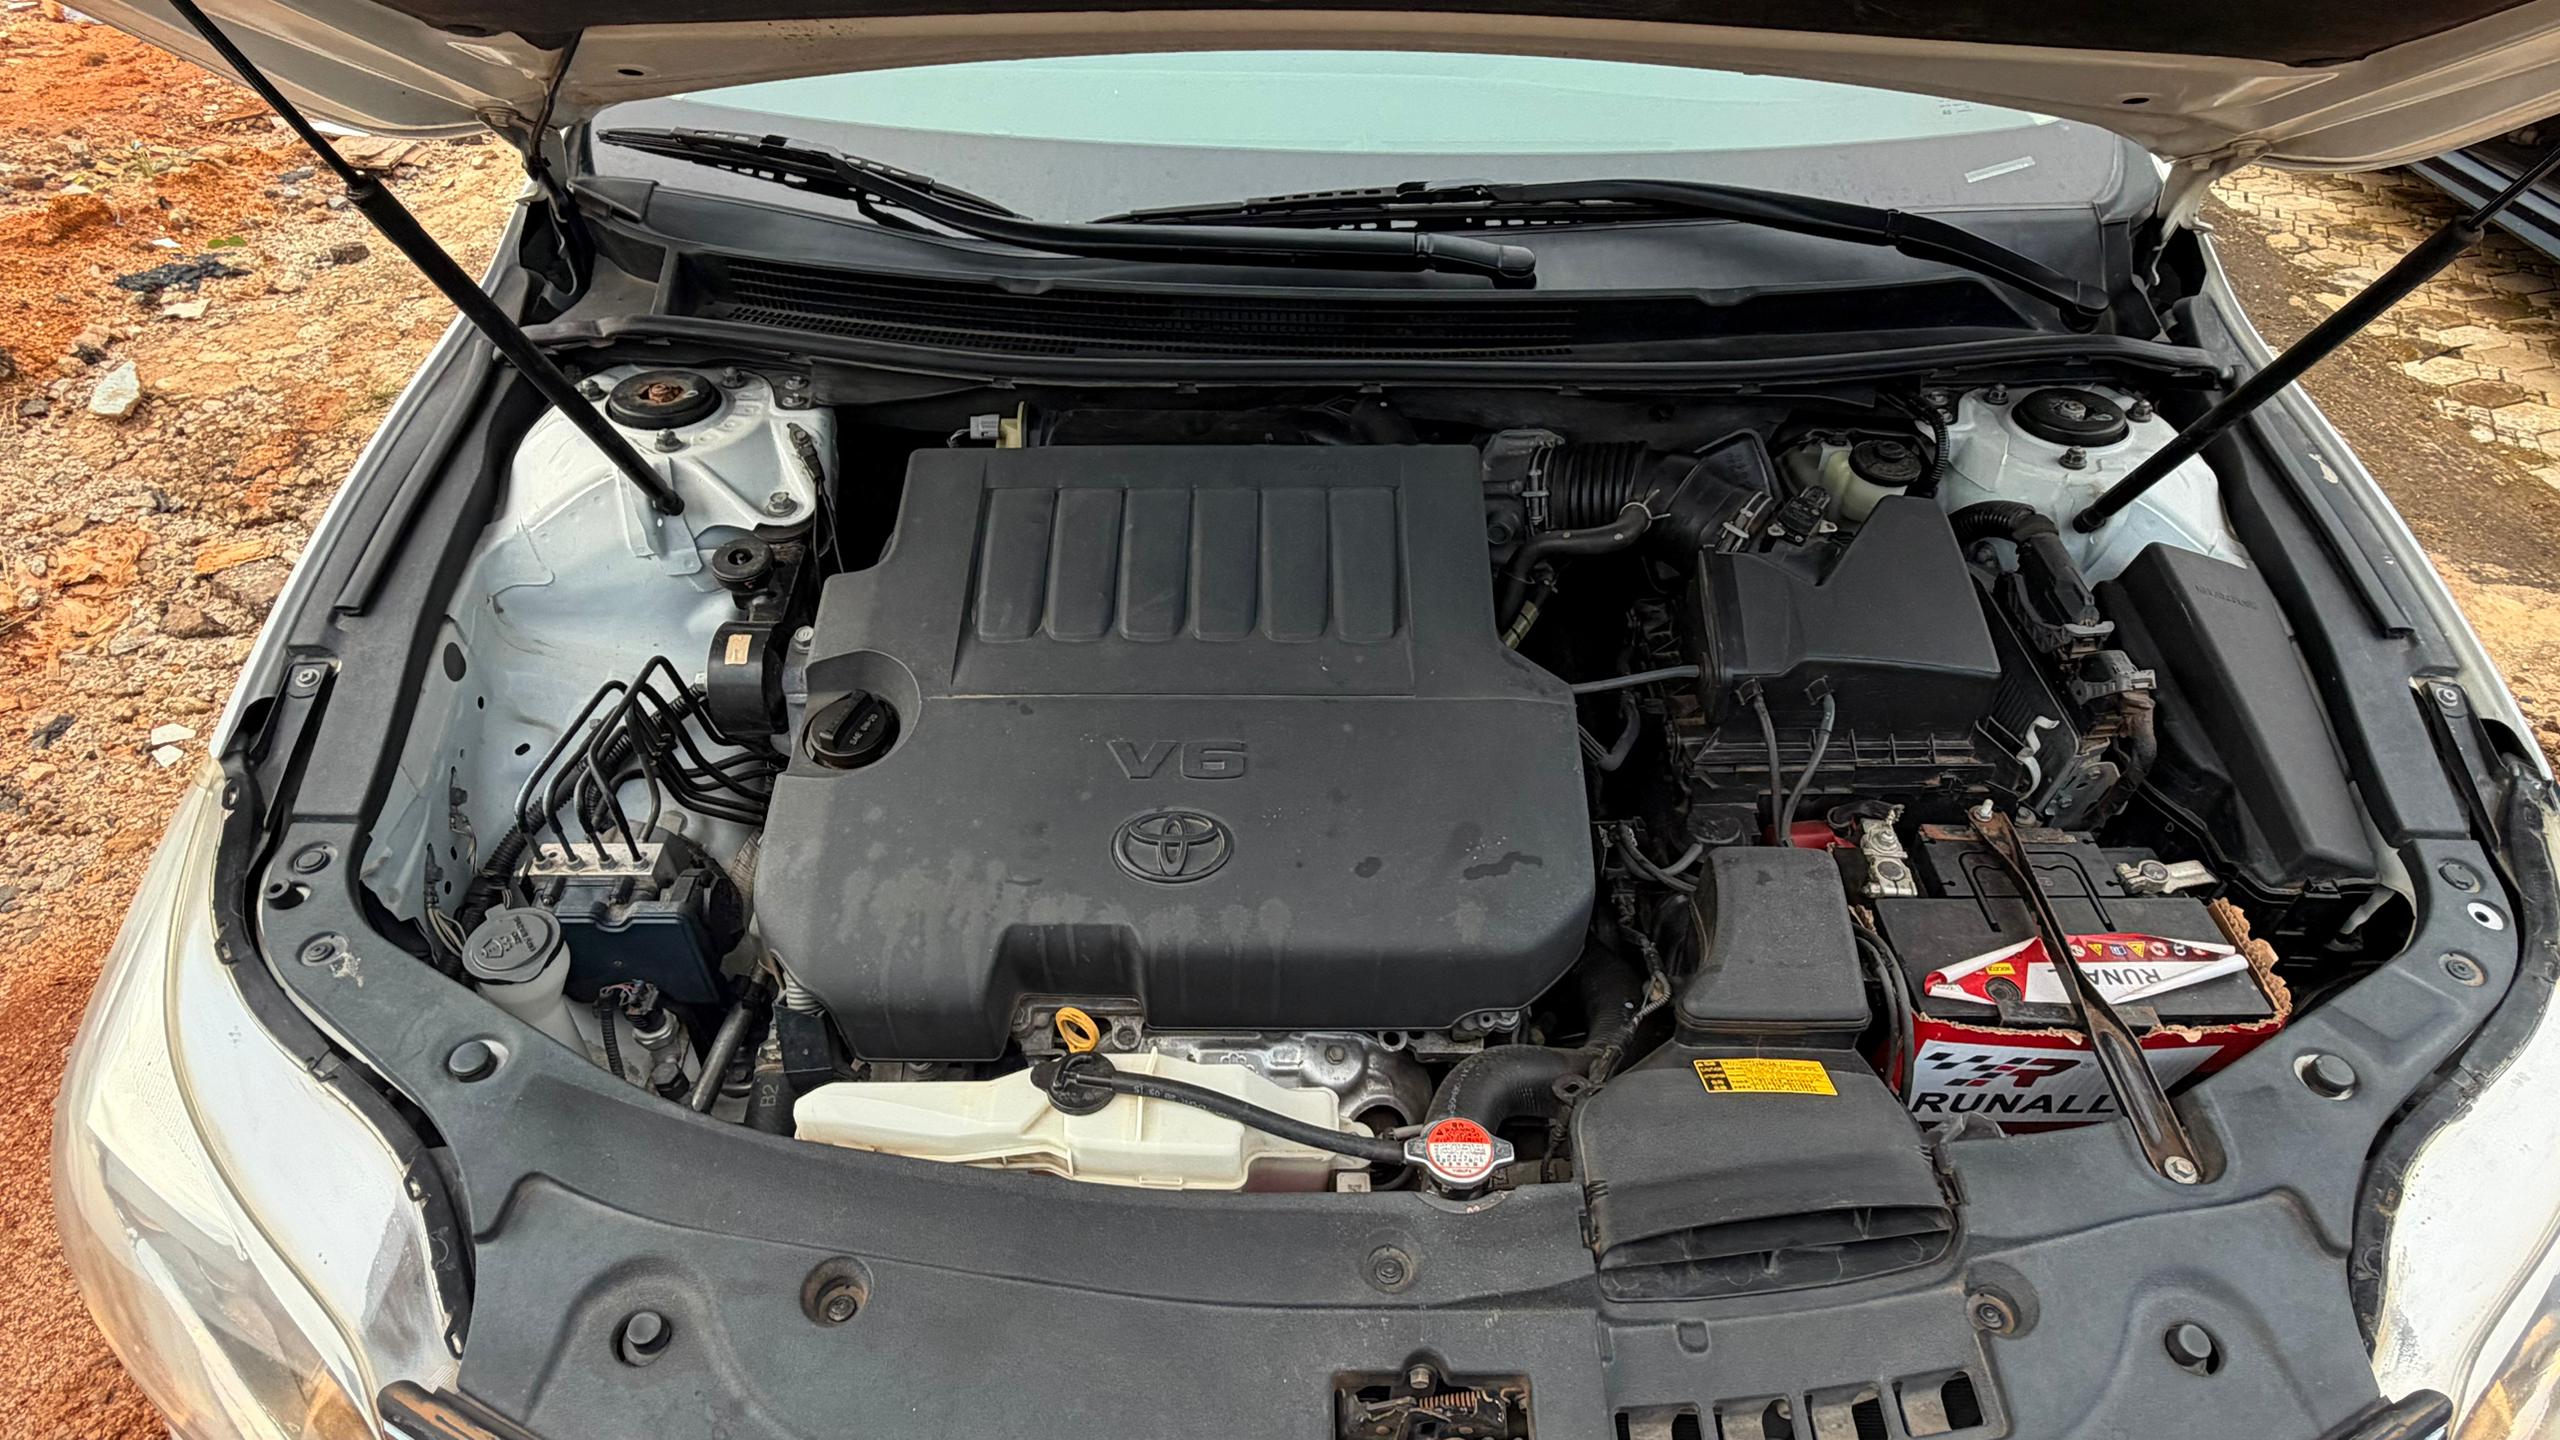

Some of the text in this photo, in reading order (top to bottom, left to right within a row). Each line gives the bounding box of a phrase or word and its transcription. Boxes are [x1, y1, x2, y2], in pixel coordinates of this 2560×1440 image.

[1106, 739, 1248, 780] V6
[2048, 968, 2161, 986] RUNA
[760, 1083, 780, 1107] B2
[1911, 1092, 2116, 1114] RUNALL
